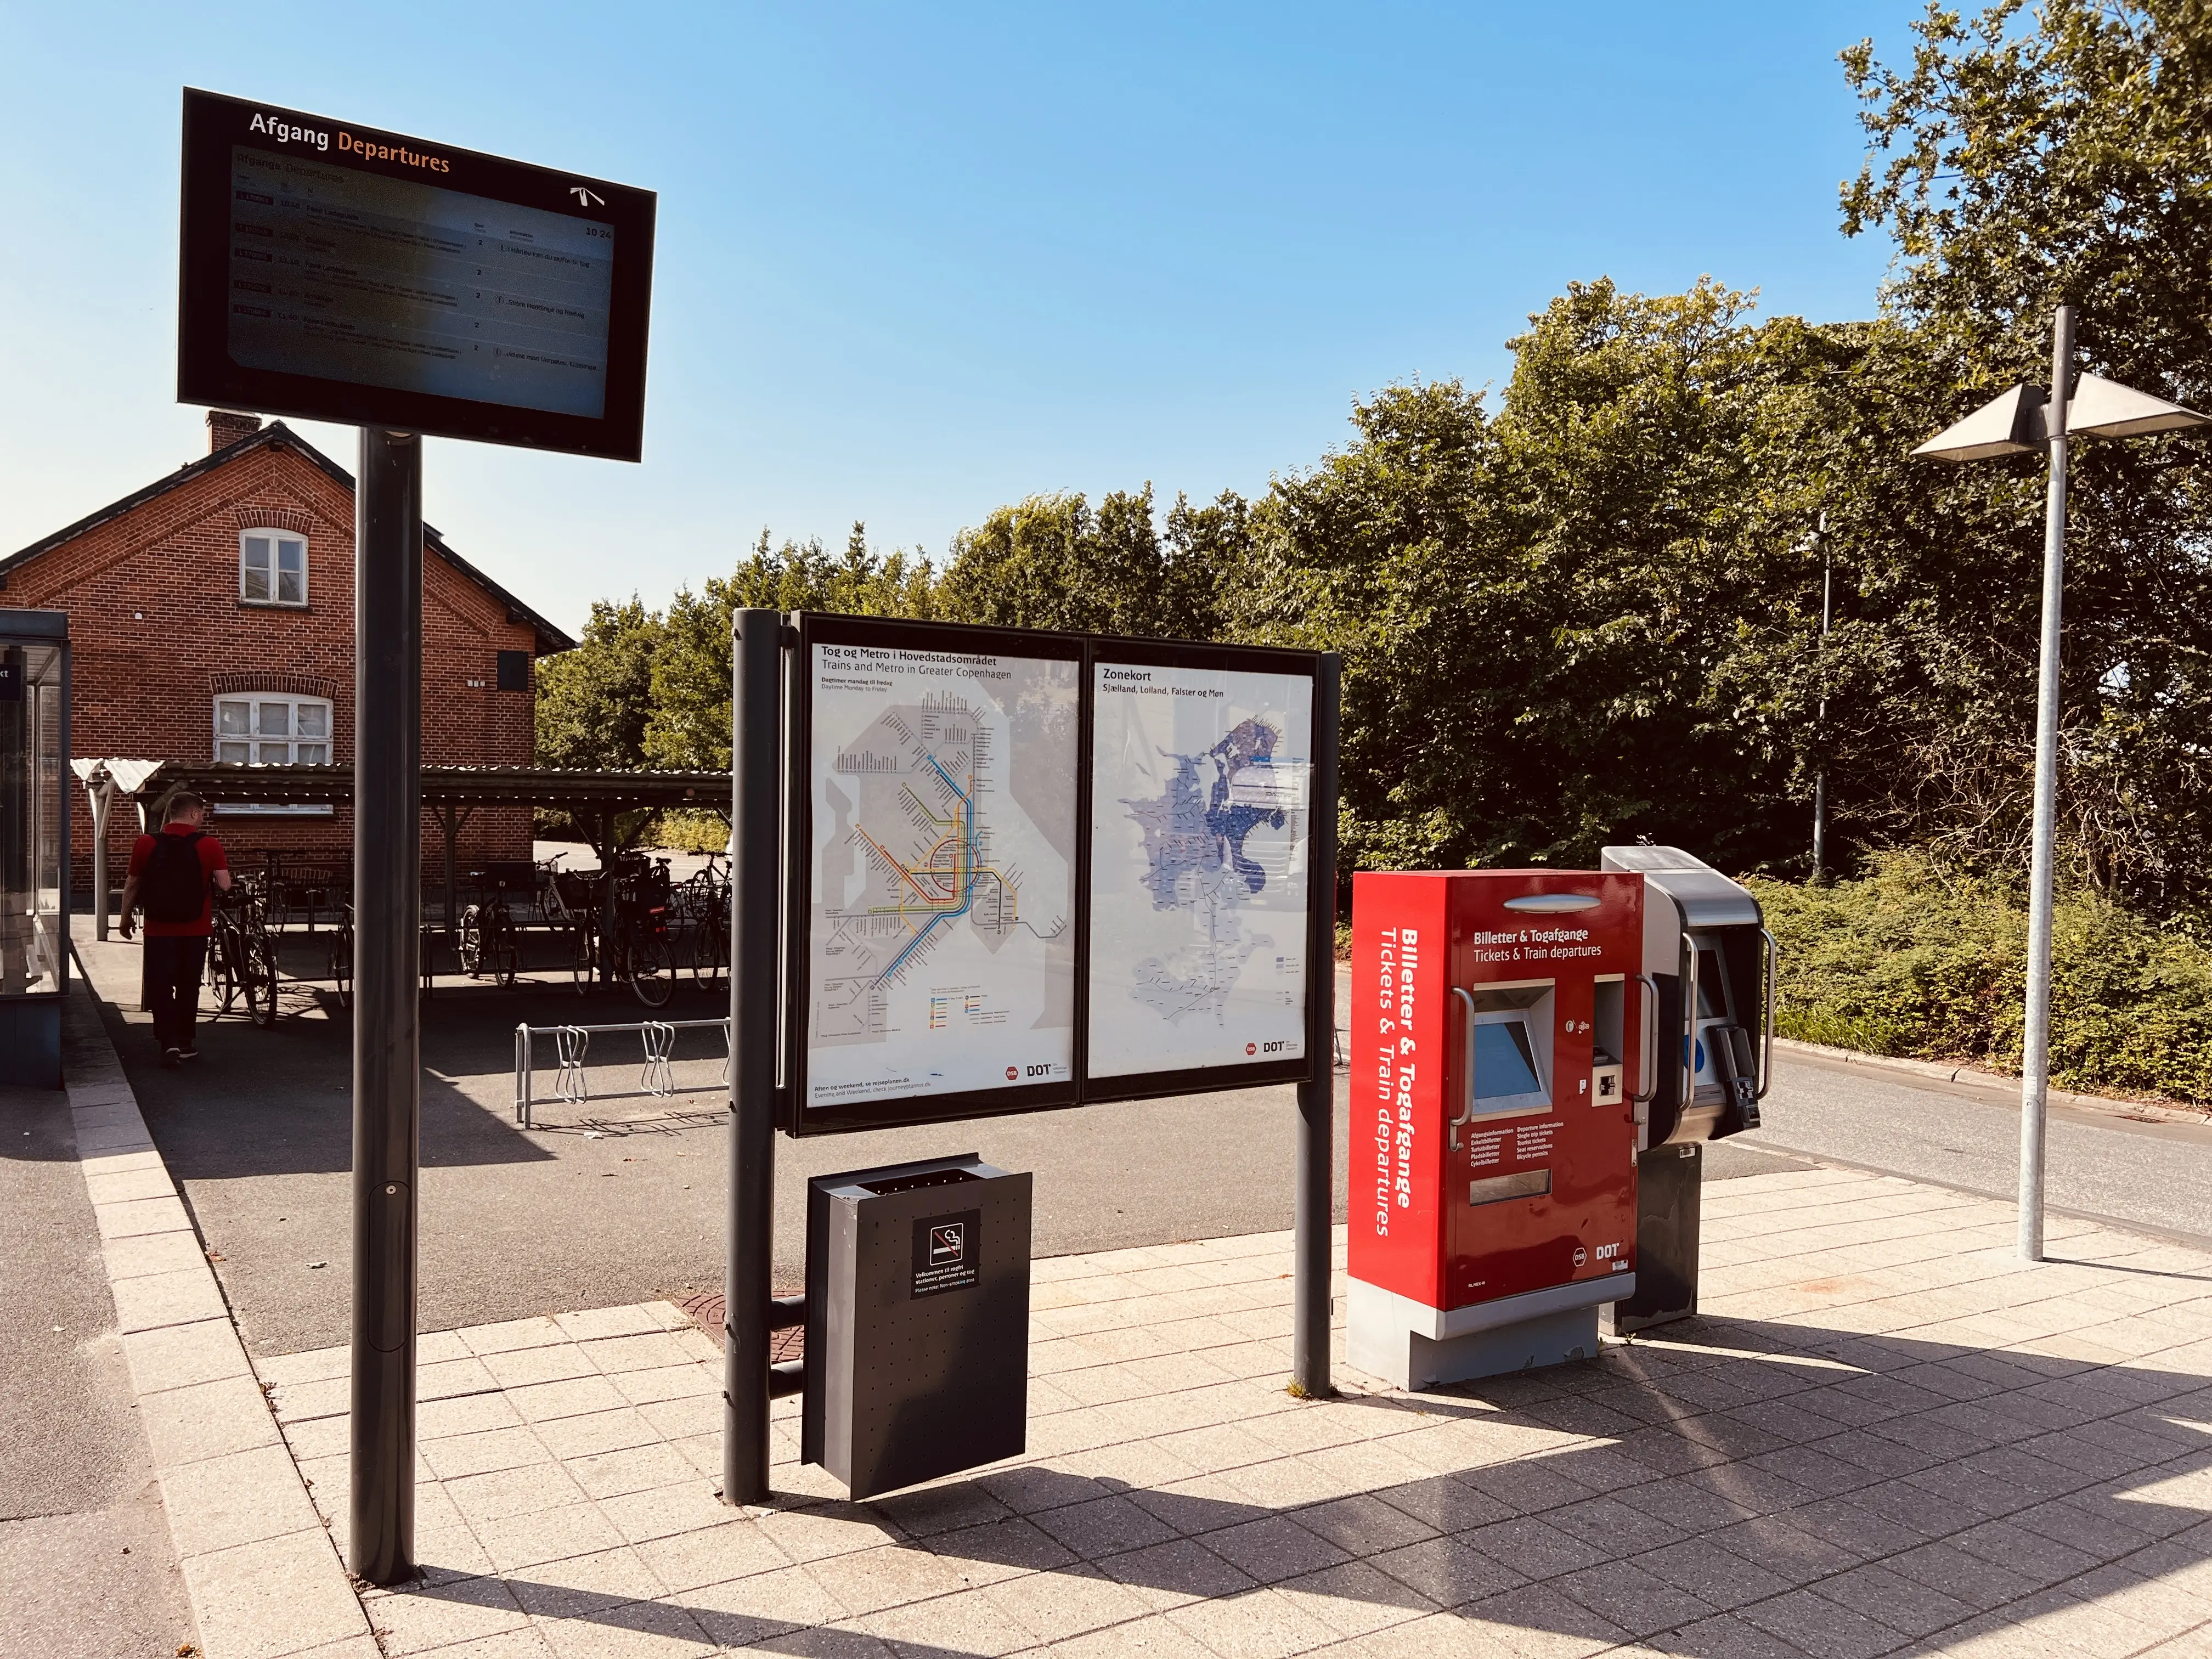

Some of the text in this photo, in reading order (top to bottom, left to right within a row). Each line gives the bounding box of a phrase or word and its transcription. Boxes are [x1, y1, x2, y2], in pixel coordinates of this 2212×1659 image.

[250, 113, 449, 173] Afgang Departures
[821, 646, 997, 665] Tog og Metro i Hovedstadsområdet
[822, 659, 1012, 680] Trains and Metro in Greater Copenhagen
[1103, 668, 1152, 681] Zonekort
[1103, 684, 1138, 694] Sjælland,
[1140, 686, 1169, 696] Lolland,
[1172, 687, 1195, 696] Falster
[1198, 690, 1207, 698] og
[1474, 928, 1588, 945] Billetter & Togafgange
[1474, 945, 1602, 962] Tickets & Train departures
[1263, 1041, 1284, 1052] DOT
[1026, 1064, 1050, 1076] DOT
[1395, 928, 1418, 1208] Billetter & Togafgange
[872, 1077, 910, 1086] rejseplanen.dk
[1374, 927, 1397, 1237] Tickets & Train departures
[1471, 1128, 1514, 1139] Afgangsinformation
[1596, 1243, 1620, 1260] DOT
[916, 1269, 943, 1278] Velkommen
[916, 1277, 938, 1285] stationer,
[939, 1273, 958, 1281] perroner
[940, 1279, 966, 1288] Non-smoking
